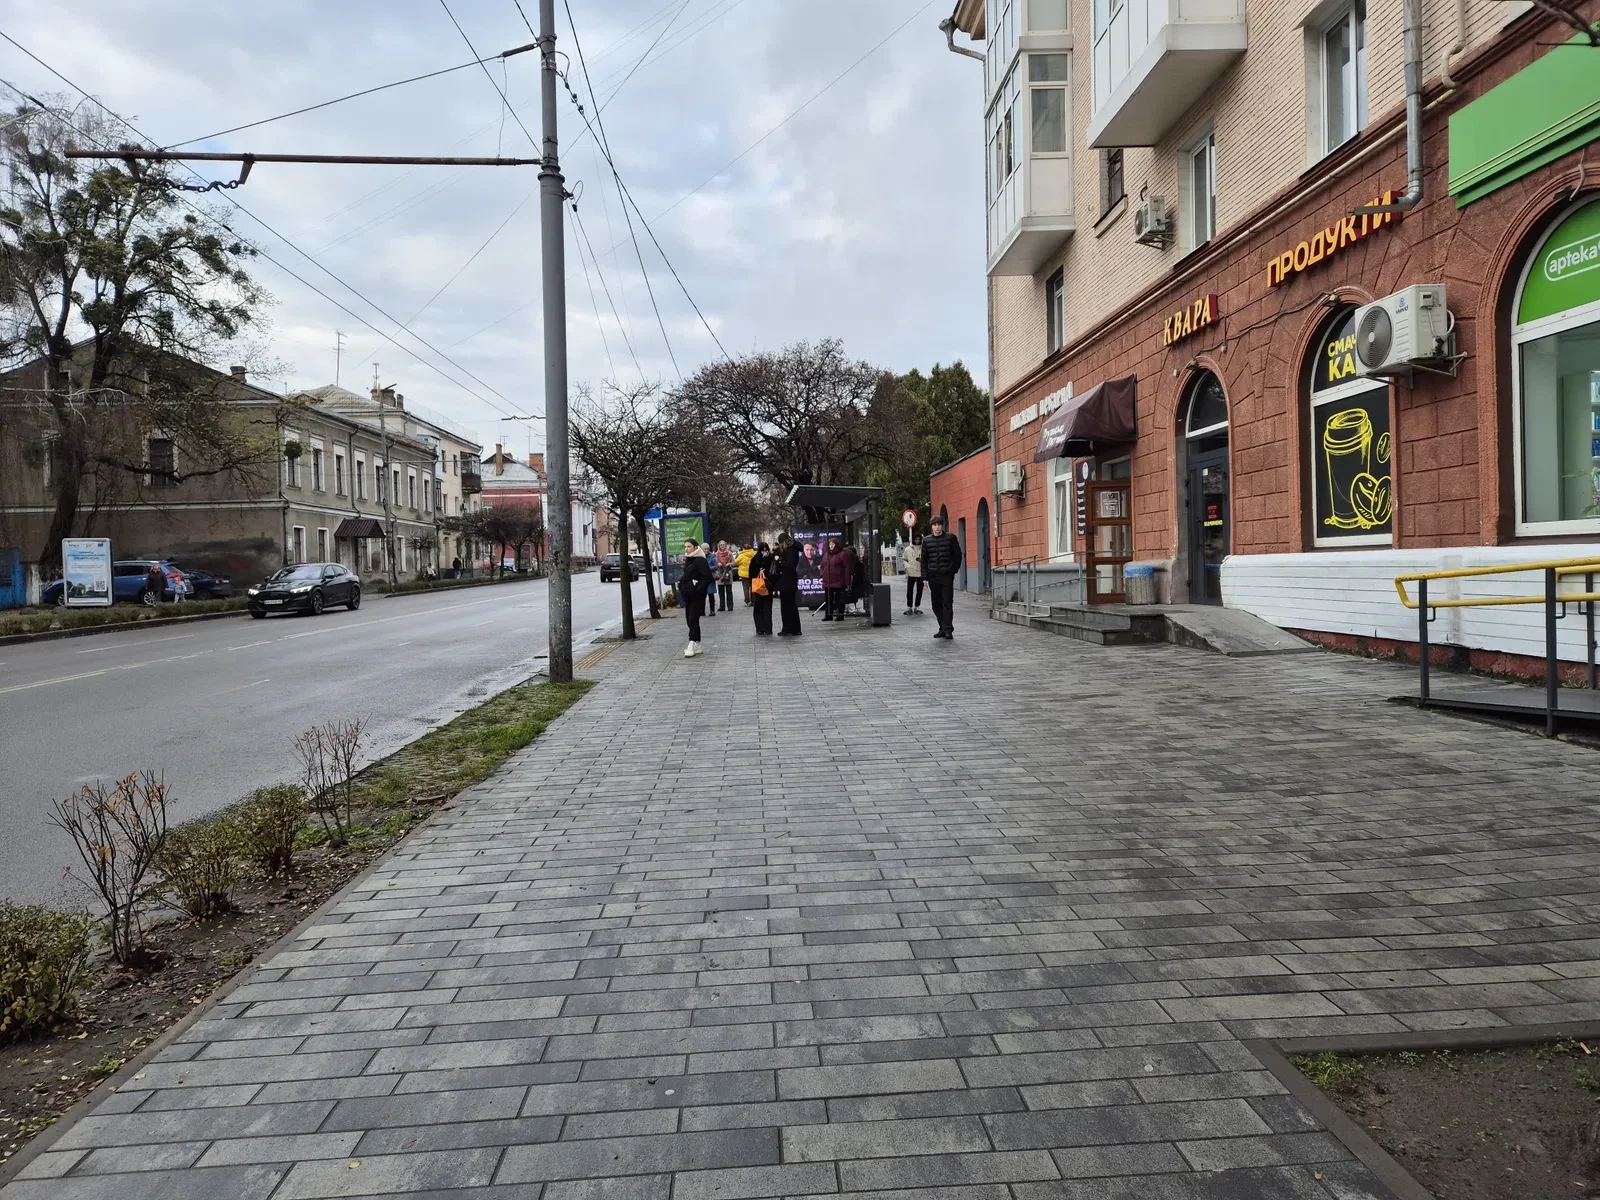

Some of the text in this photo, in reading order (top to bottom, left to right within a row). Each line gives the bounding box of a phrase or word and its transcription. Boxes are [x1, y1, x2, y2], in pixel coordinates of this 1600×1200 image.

[1267, 190, 1392, 288] ПРОДУКТИ
[1549, 245, 1598, 275] apteka
[1163, 294, 1212, 346] КВАРА
[1328, 353, 1356, 382] КА
